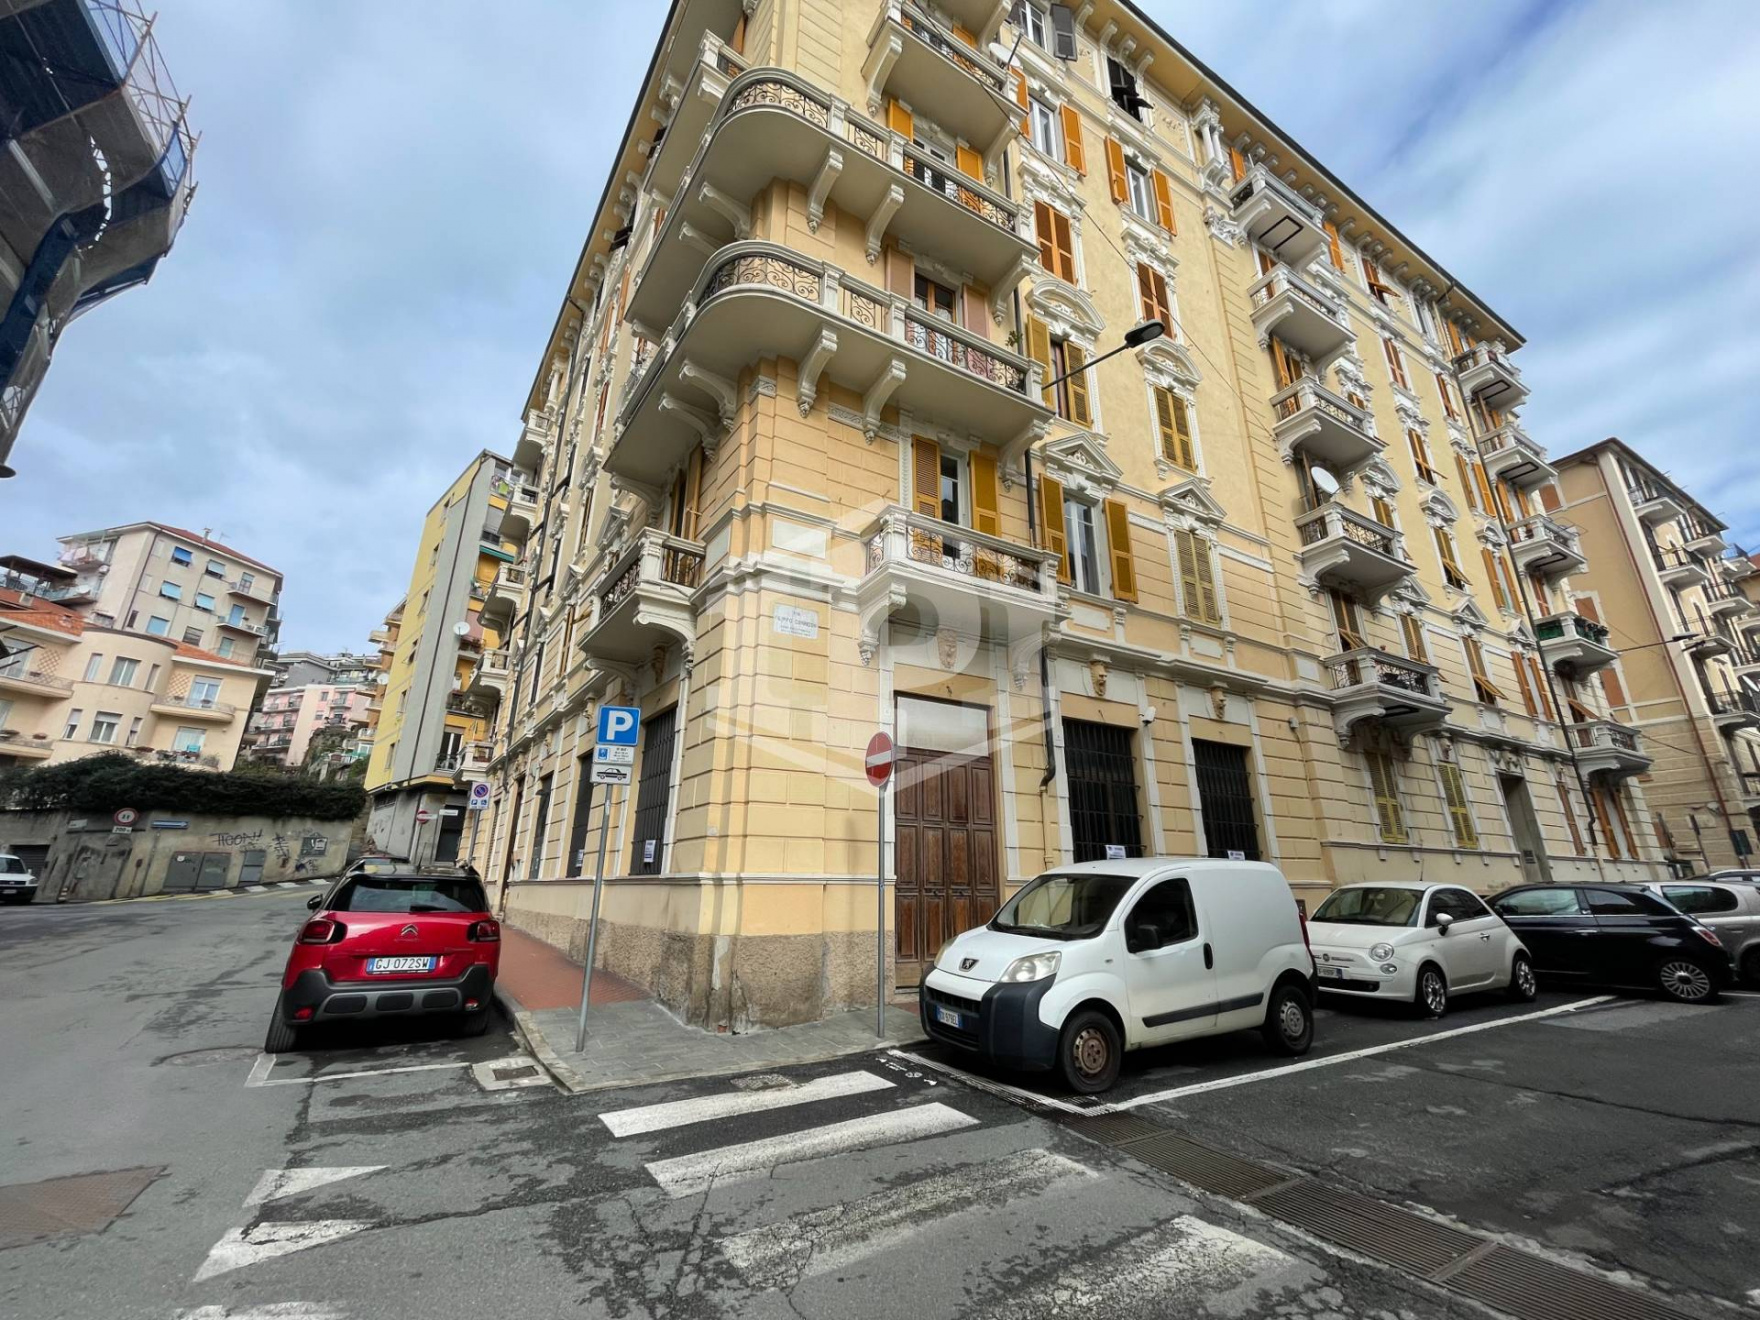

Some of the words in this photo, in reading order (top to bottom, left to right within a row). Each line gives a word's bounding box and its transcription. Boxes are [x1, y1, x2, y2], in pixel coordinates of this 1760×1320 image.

[606, 710, 633, 741] P
[375, 958, 390, 969] GJ
[393, 957, 429, 969] 072SW
